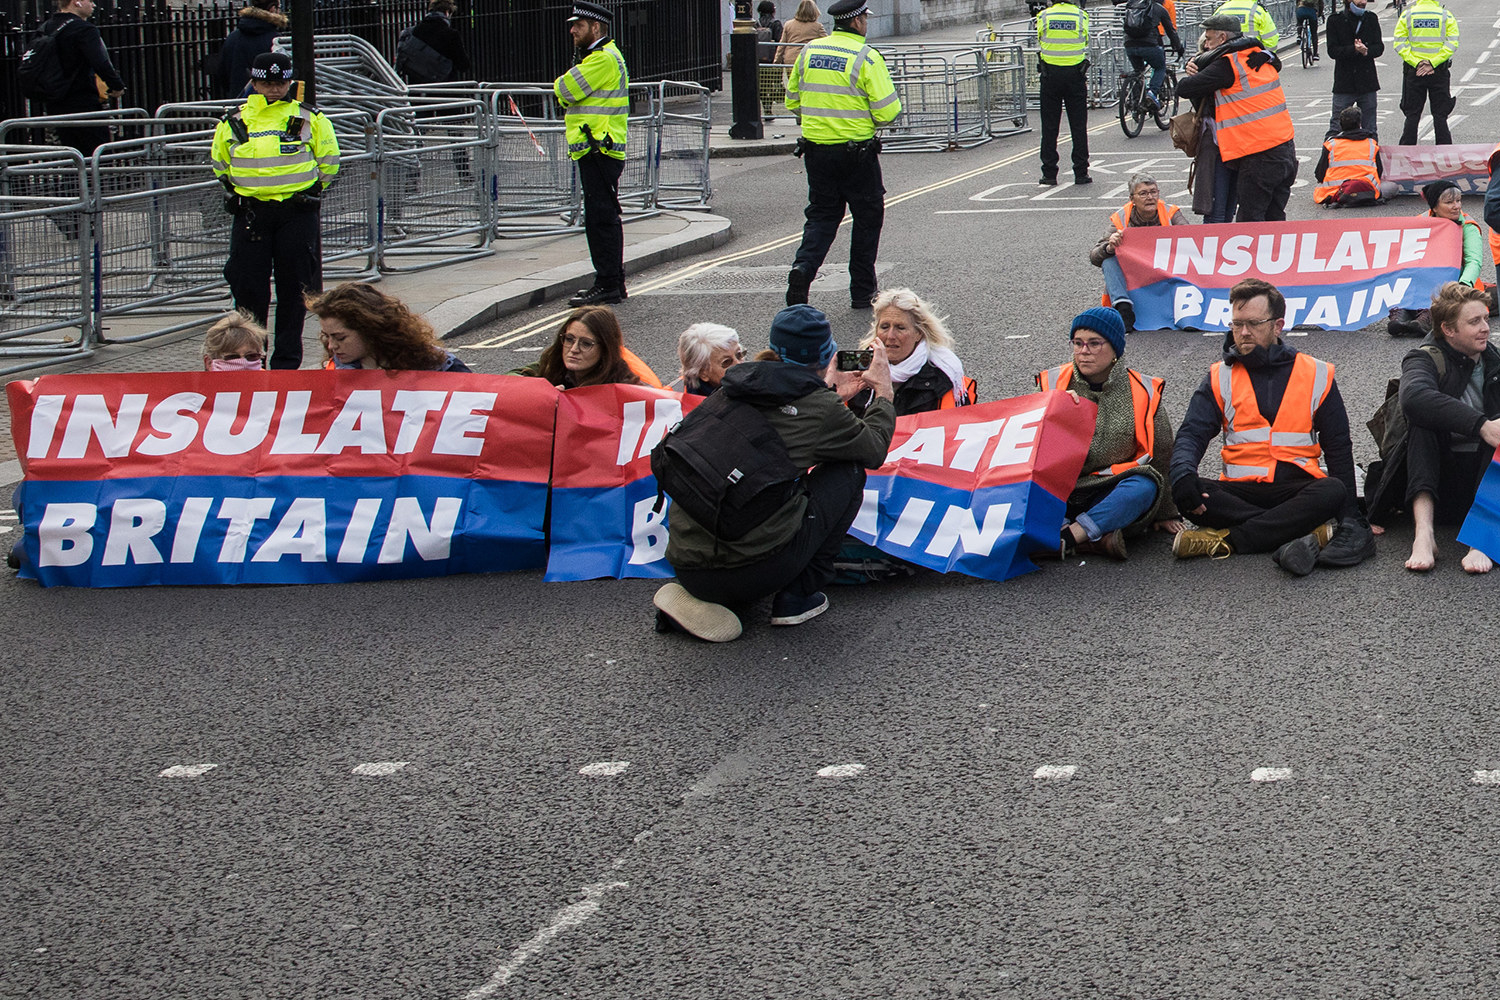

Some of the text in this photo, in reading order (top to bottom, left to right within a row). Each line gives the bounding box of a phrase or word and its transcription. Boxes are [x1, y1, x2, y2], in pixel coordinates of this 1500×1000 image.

[810, 59, 846, 71] POLICE
[1153, 227, 1431, 276] INSULATE
[1174, 278, 1412, 331] BRTAIN
[26, 389, 498, 459] INSULATE
[38, 497, 463, 568] BRITAIN
